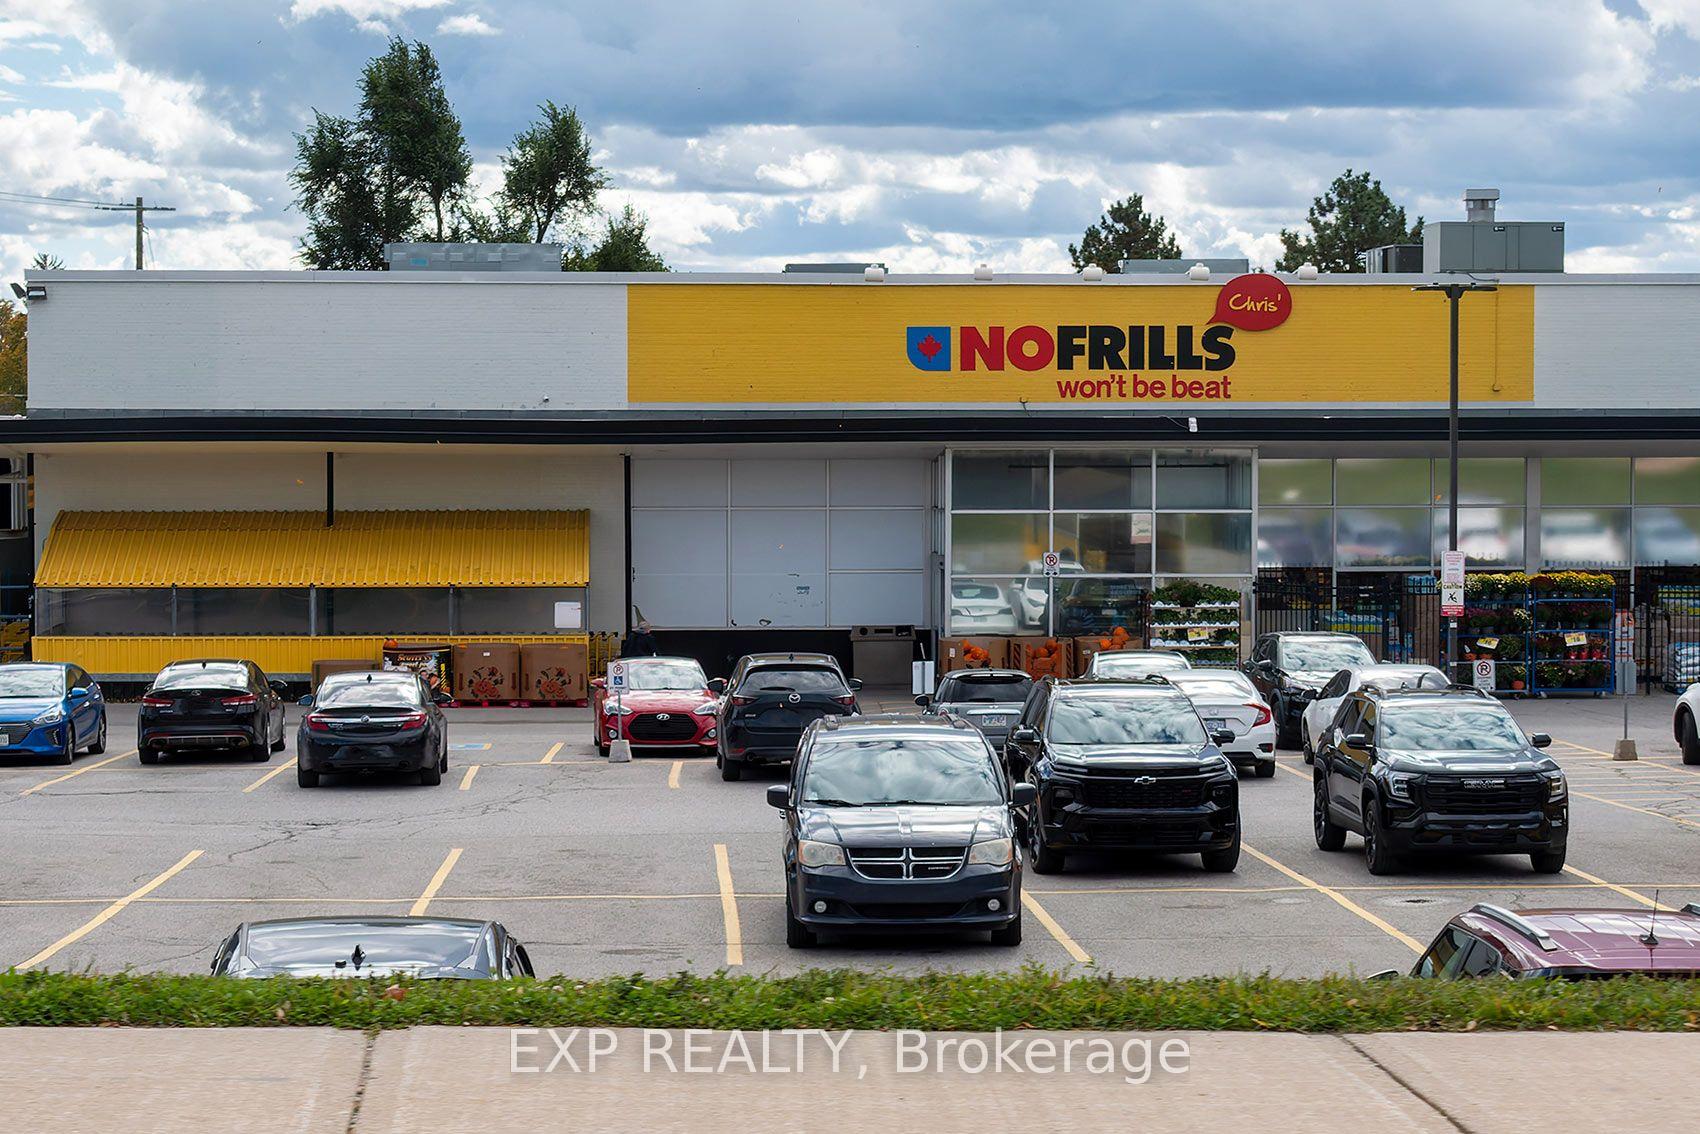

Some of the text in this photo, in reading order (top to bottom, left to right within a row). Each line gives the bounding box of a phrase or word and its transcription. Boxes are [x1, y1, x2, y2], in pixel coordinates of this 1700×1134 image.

[1229, 294, 1281, 311] Chris'
[1057, 374, 1231, 398] won't be beat
